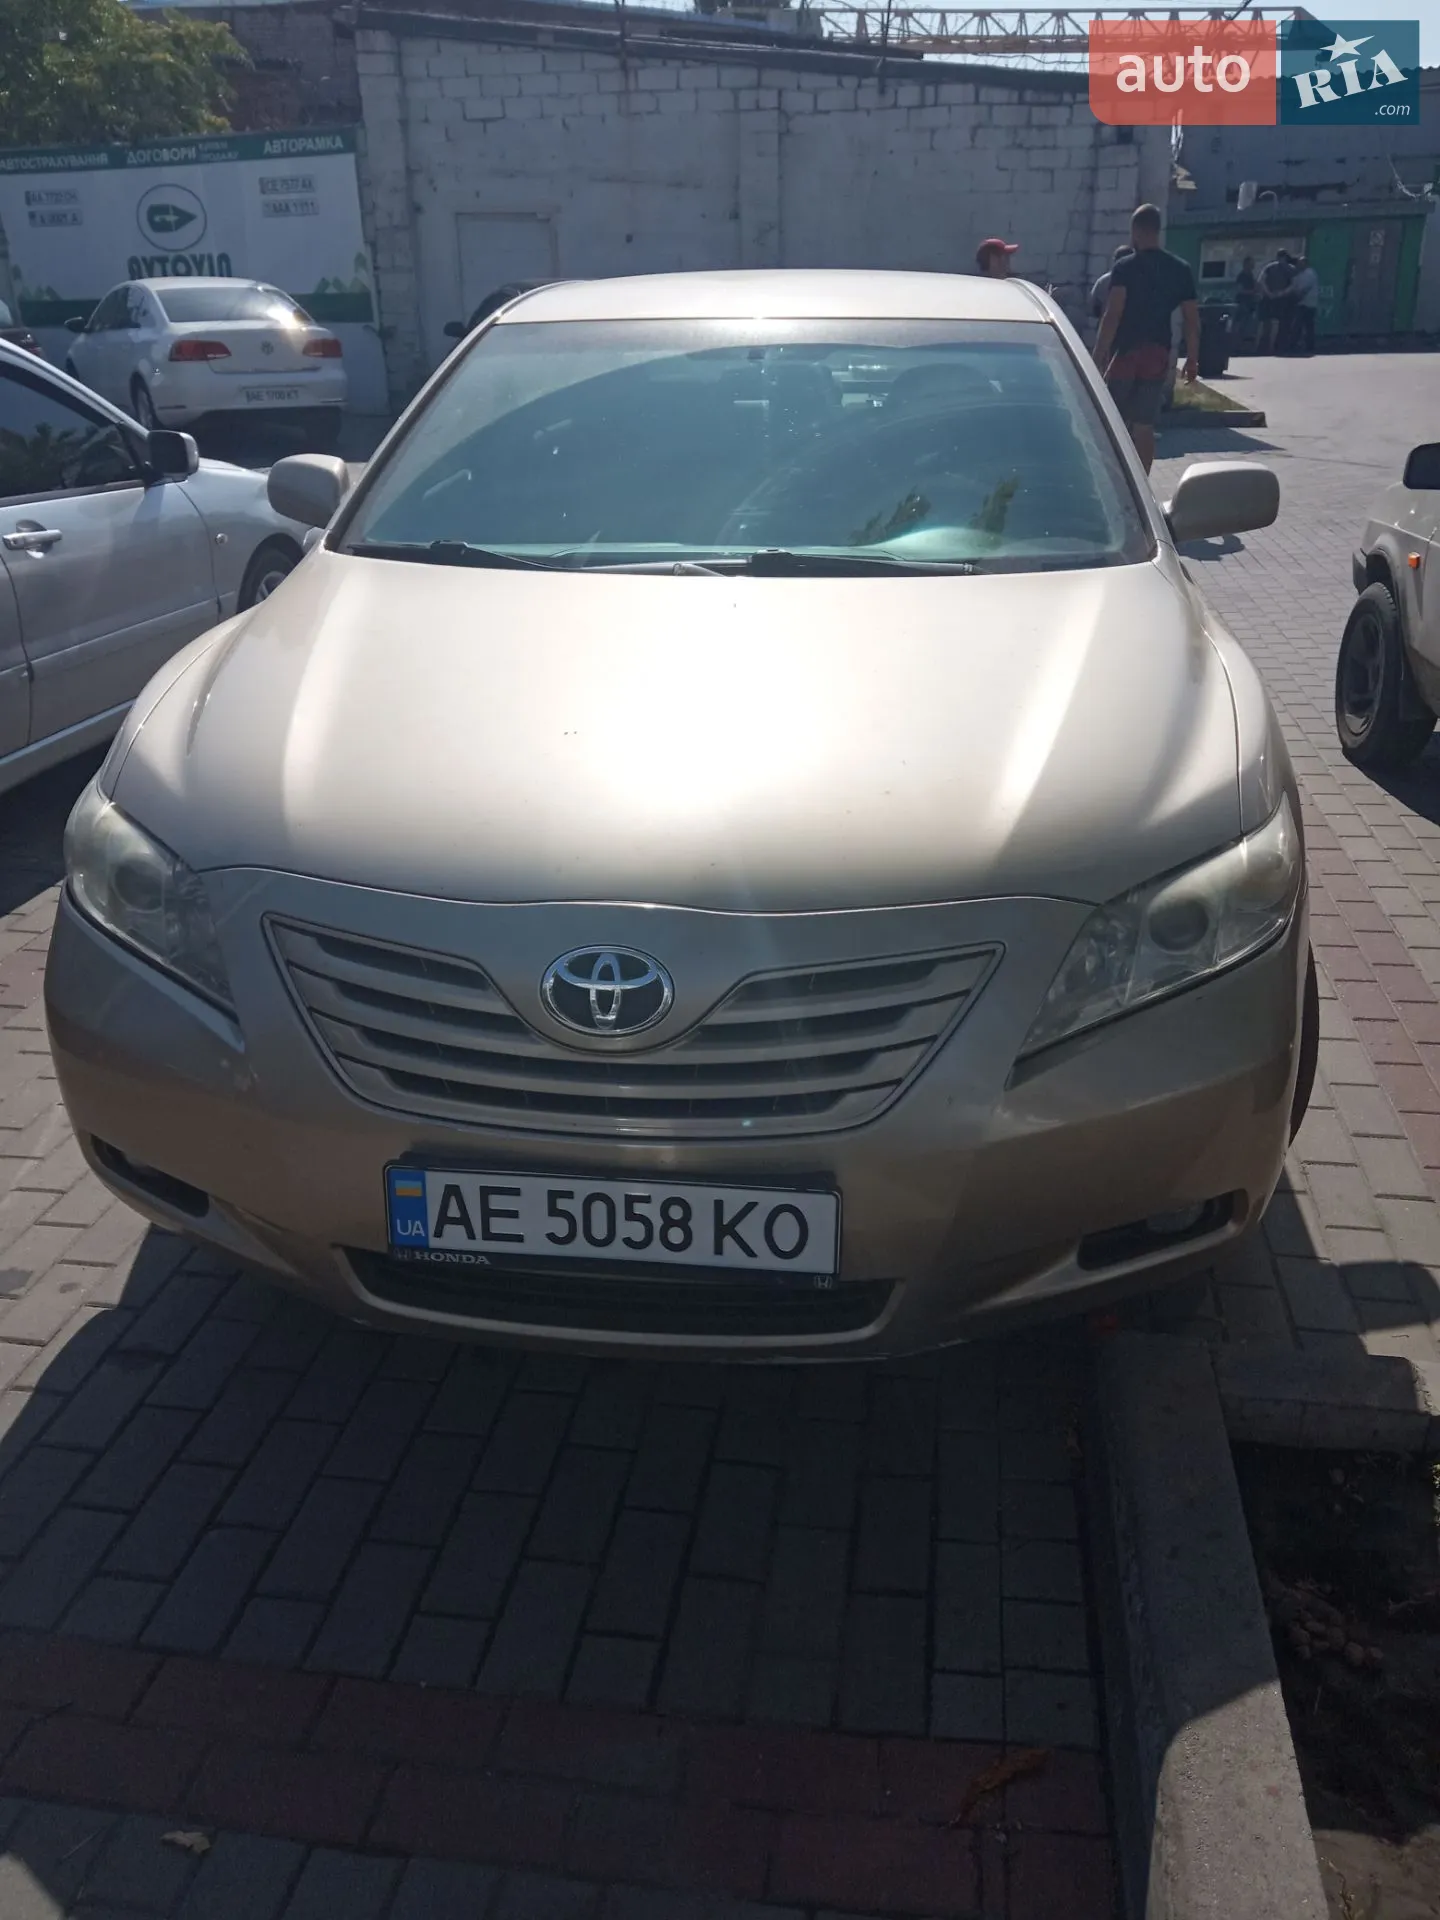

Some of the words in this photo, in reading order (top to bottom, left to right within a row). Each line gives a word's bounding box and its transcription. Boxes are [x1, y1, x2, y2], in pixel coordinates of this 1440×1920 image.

[263, 135, 344, 155] АВТОРАМКА
[396, 1219, 425, 1237] UA
[433, 1183, 525, 1243] AE
[545, 1189, 693, 1253] 5058
[713, 1199, 809, 1260] KO
[414, 1251, 492, 1265] HONDA
